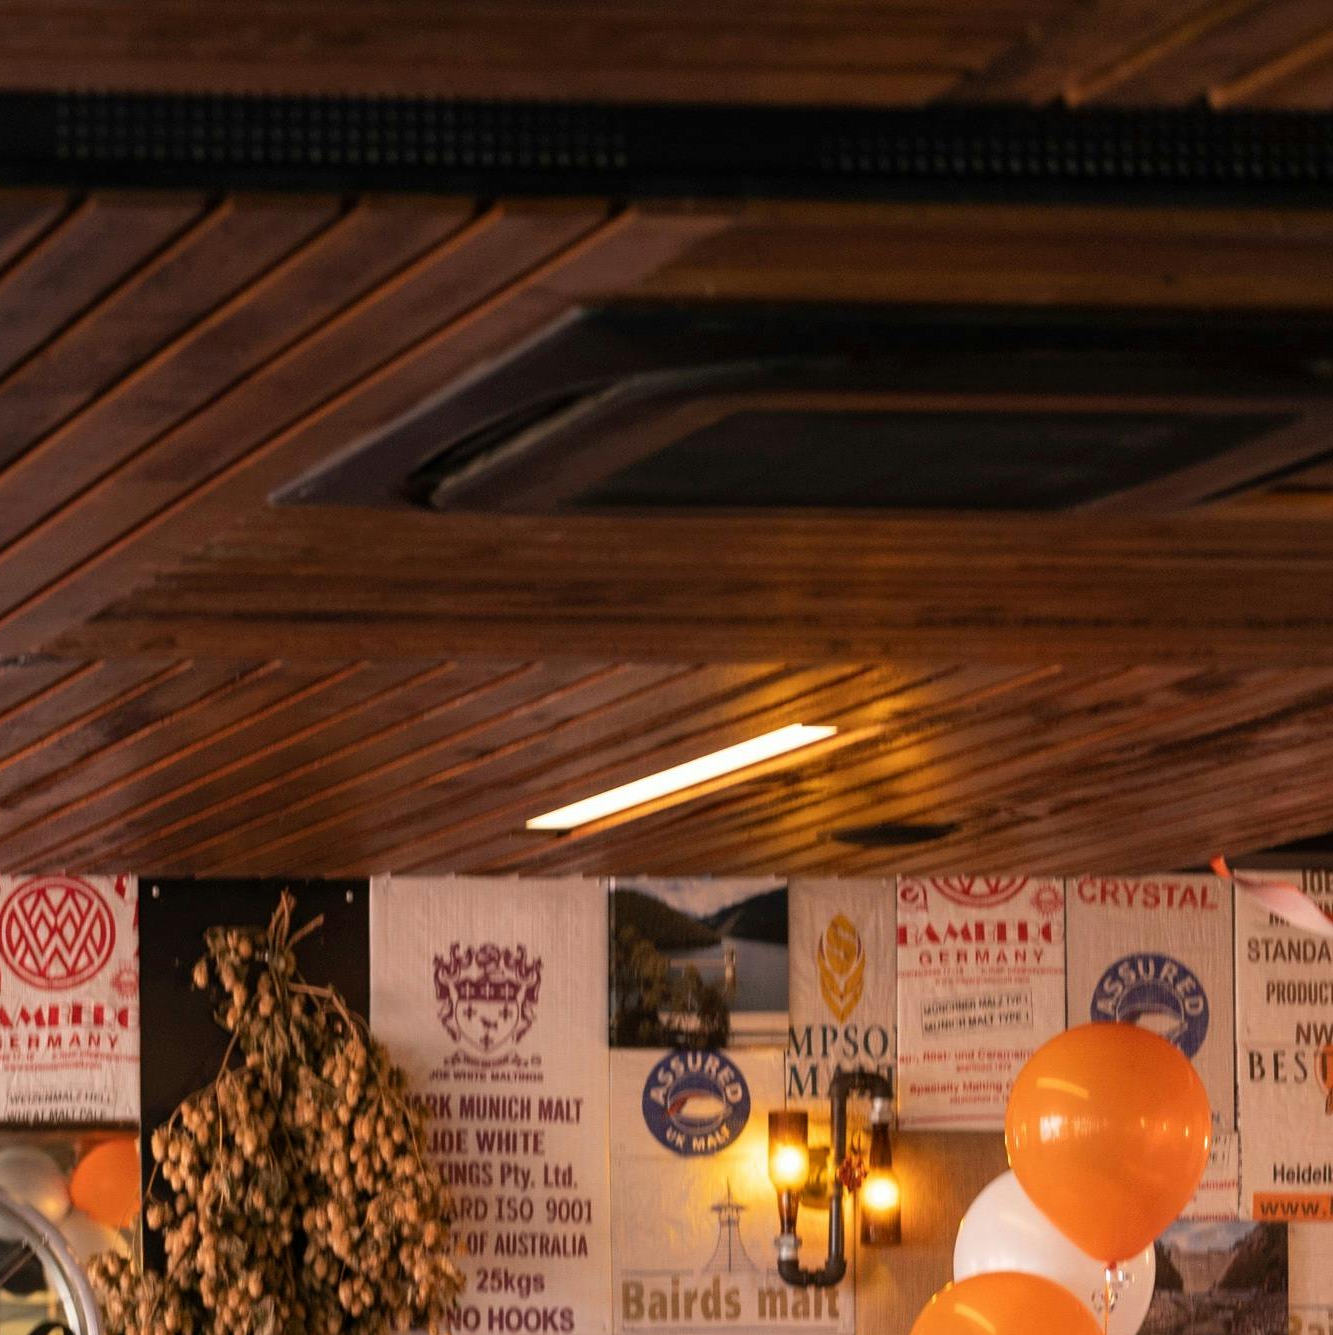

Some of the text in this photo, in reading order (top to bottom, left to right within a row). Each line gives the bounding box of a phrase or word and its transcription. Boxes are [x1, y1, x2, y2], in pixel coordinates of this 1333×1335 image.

[1077, 876, 1218, 911] CRYSTAL
[919, 950, 1044, 966] GERMANY
[1097, 957, 1204, 1018] ASSURED
[648, 1051, 745, 1104] ASSURED
[459, 1096, 582, 1124] MUNICH MALT
[432, 1130, 545, 1156] JOE WHITE
[494, 1199, 592, 1224] ISO 9001
[467, 1232, 588, 1259] OF AUSTRALIA
[476, 1270, 545, 1298] 25kgs
[623, 1276, 839, 1323] Bairds malt
[488, 1307, 574, 1333] HOOKS
